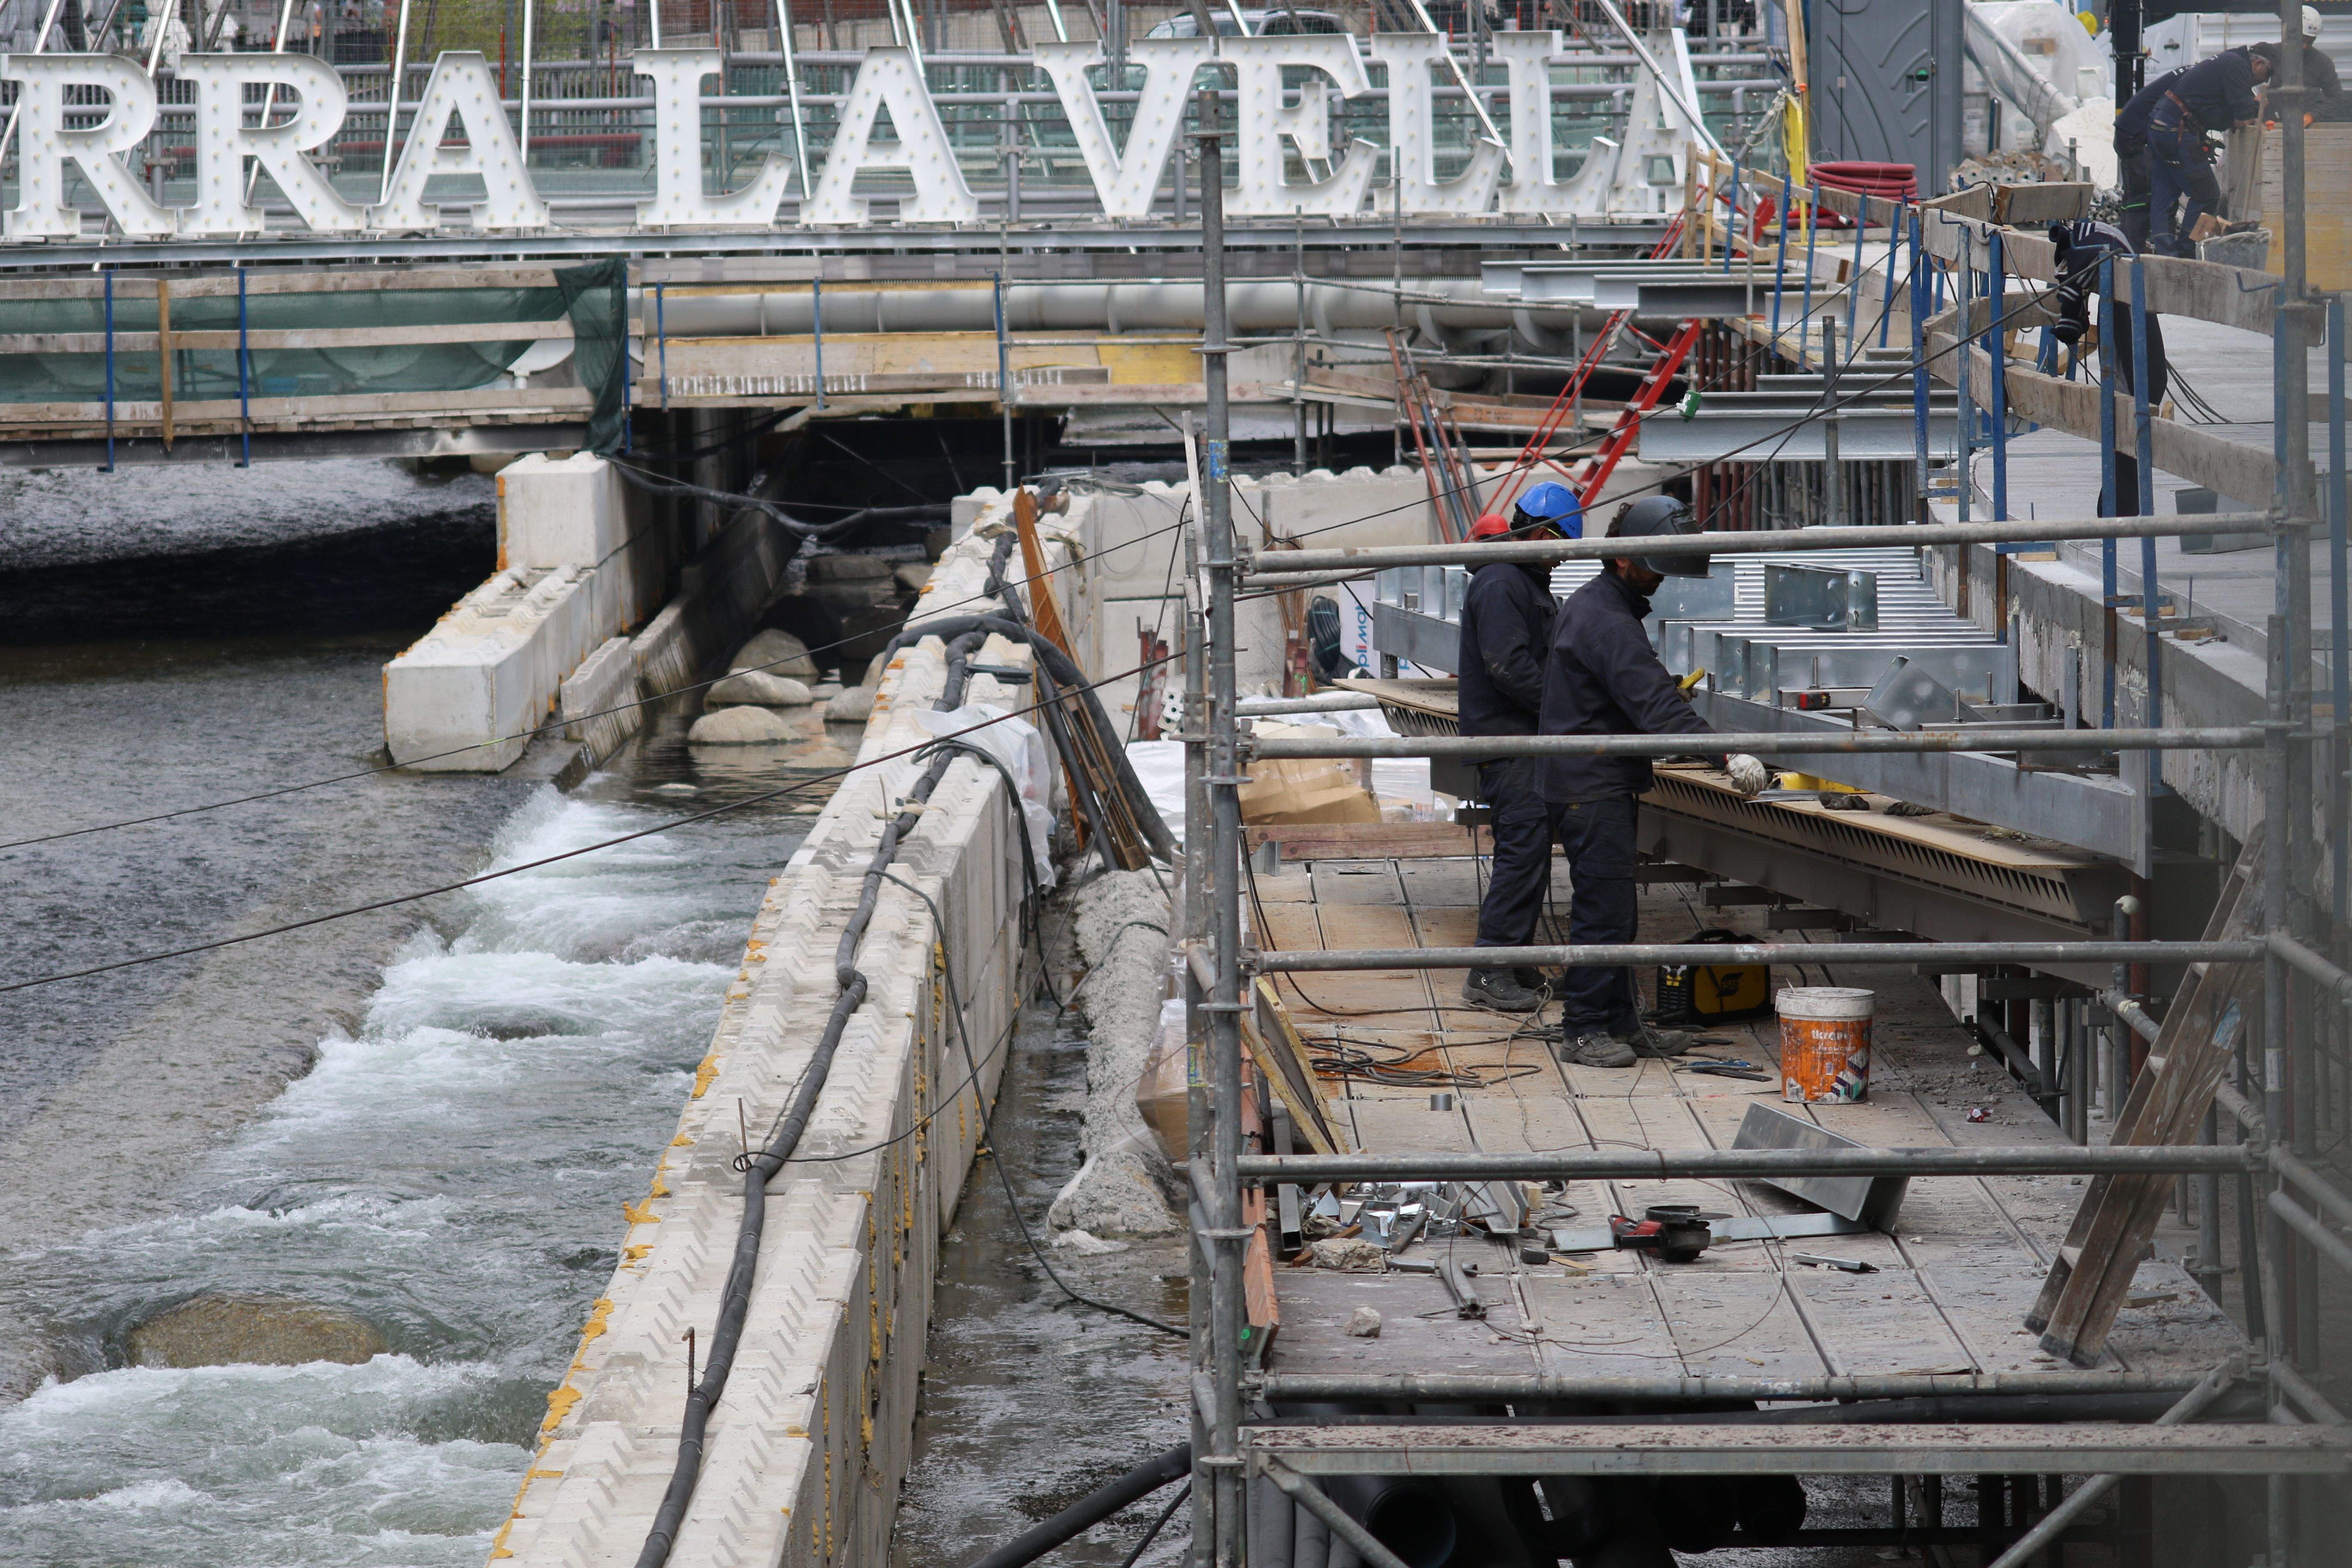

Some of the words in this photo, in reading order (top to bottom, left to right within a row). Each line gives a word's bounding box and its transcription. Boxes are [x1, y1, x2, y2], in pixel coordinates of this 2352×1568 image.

[634, 45, 978, 225] LA
[1033, 28, 1719, 217] VELLA
[1355, 605, 1369, 667] plimat
[1721, 979, 1739, 990] ESAB
